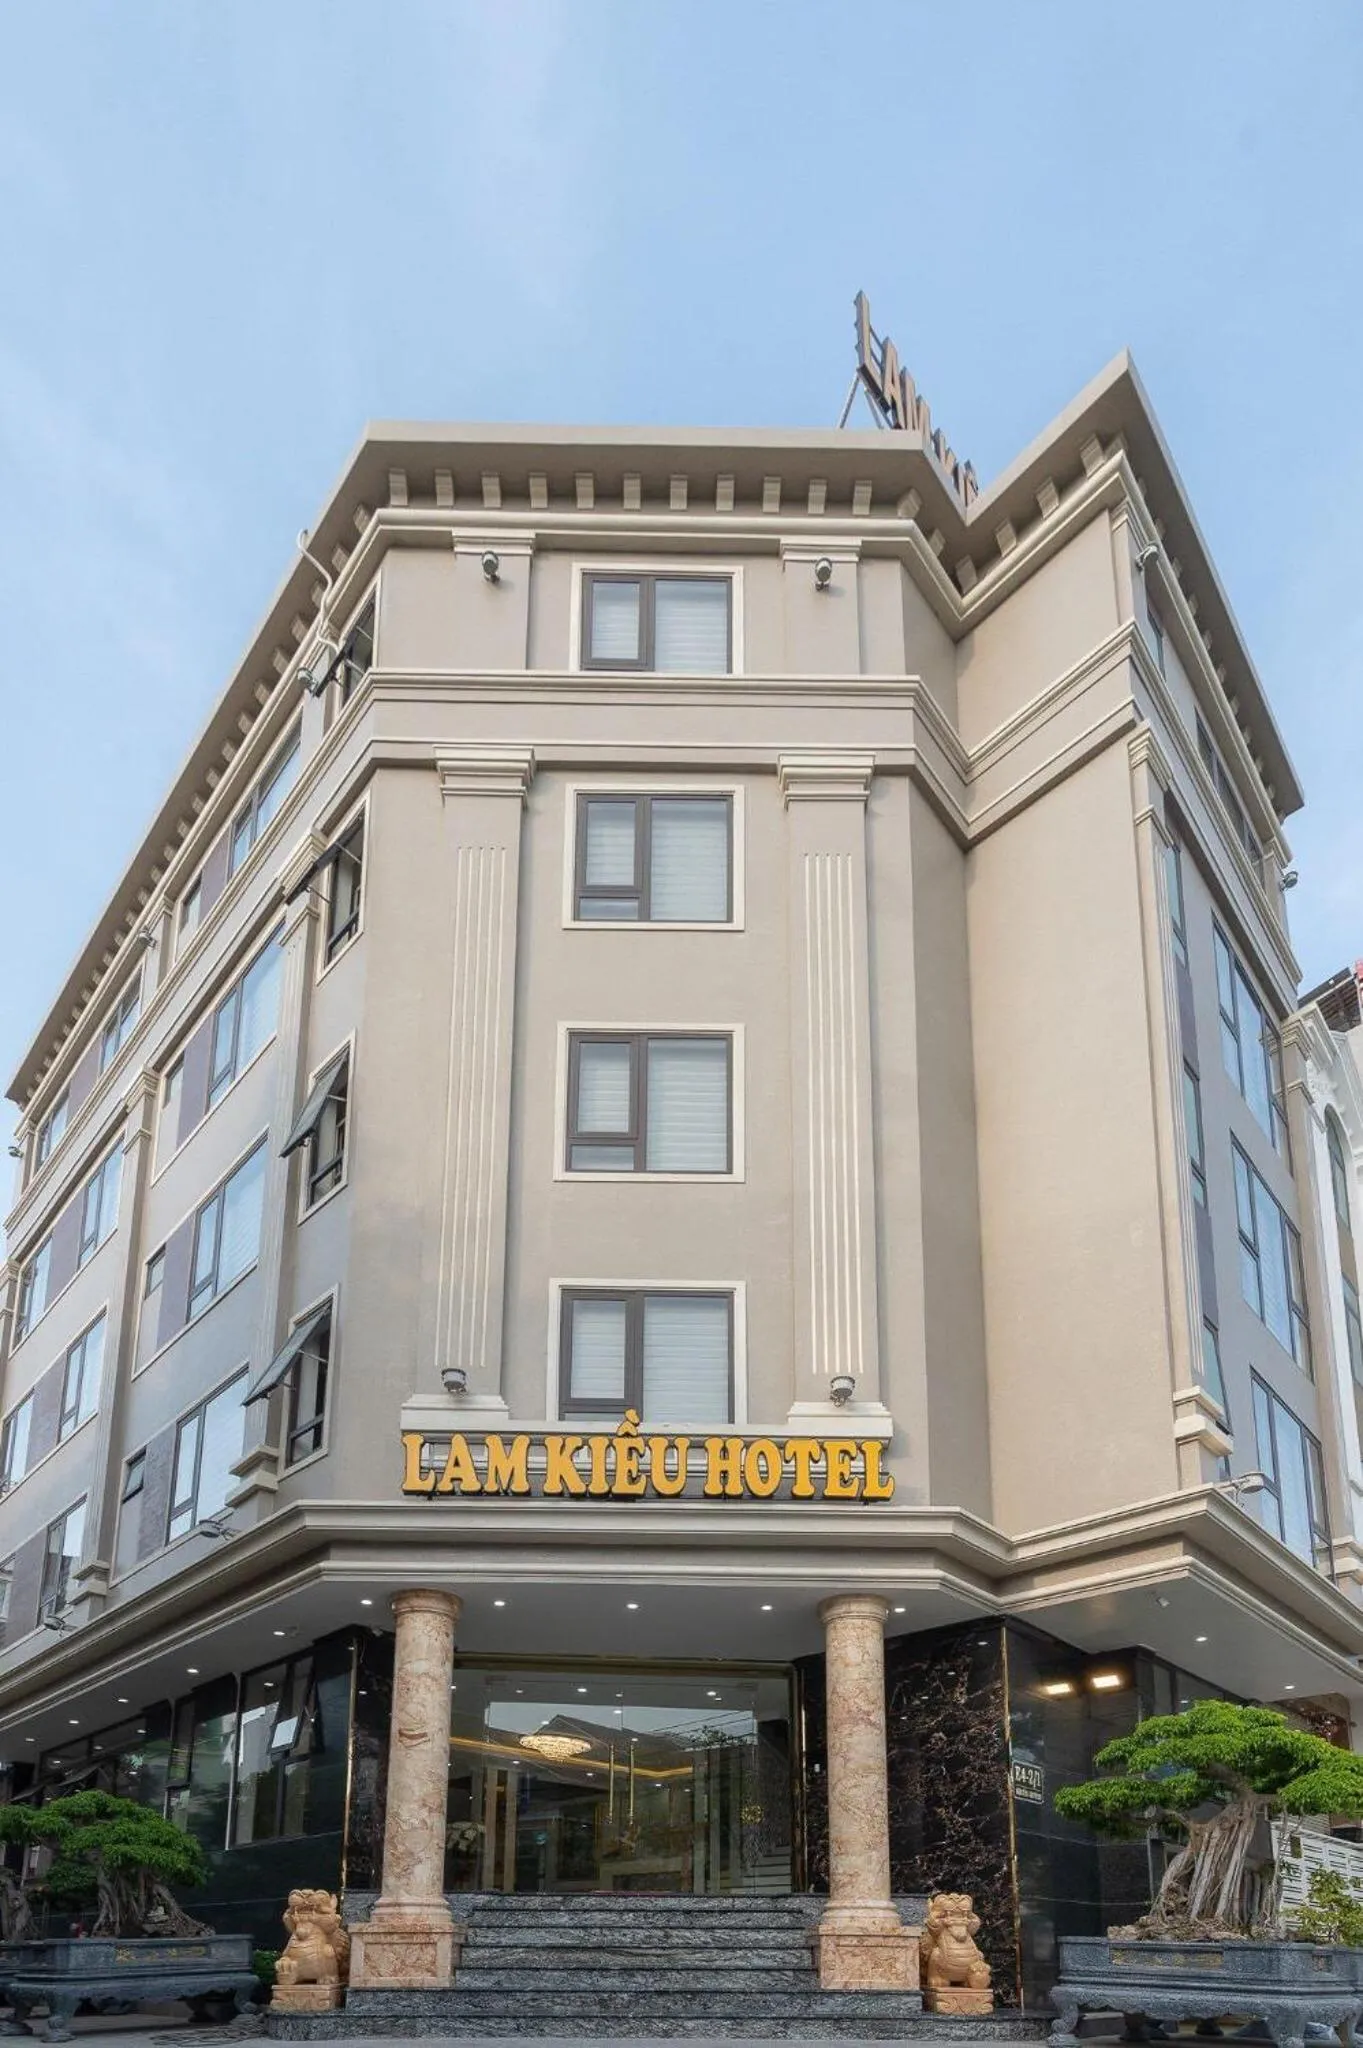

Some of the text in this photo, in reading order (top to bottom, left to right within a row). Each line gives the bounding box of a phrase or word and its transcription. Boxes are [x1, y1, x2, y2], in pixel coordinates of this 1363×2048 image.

[402, 1409, 895, 1501] LAM KIỀU HOTEL
